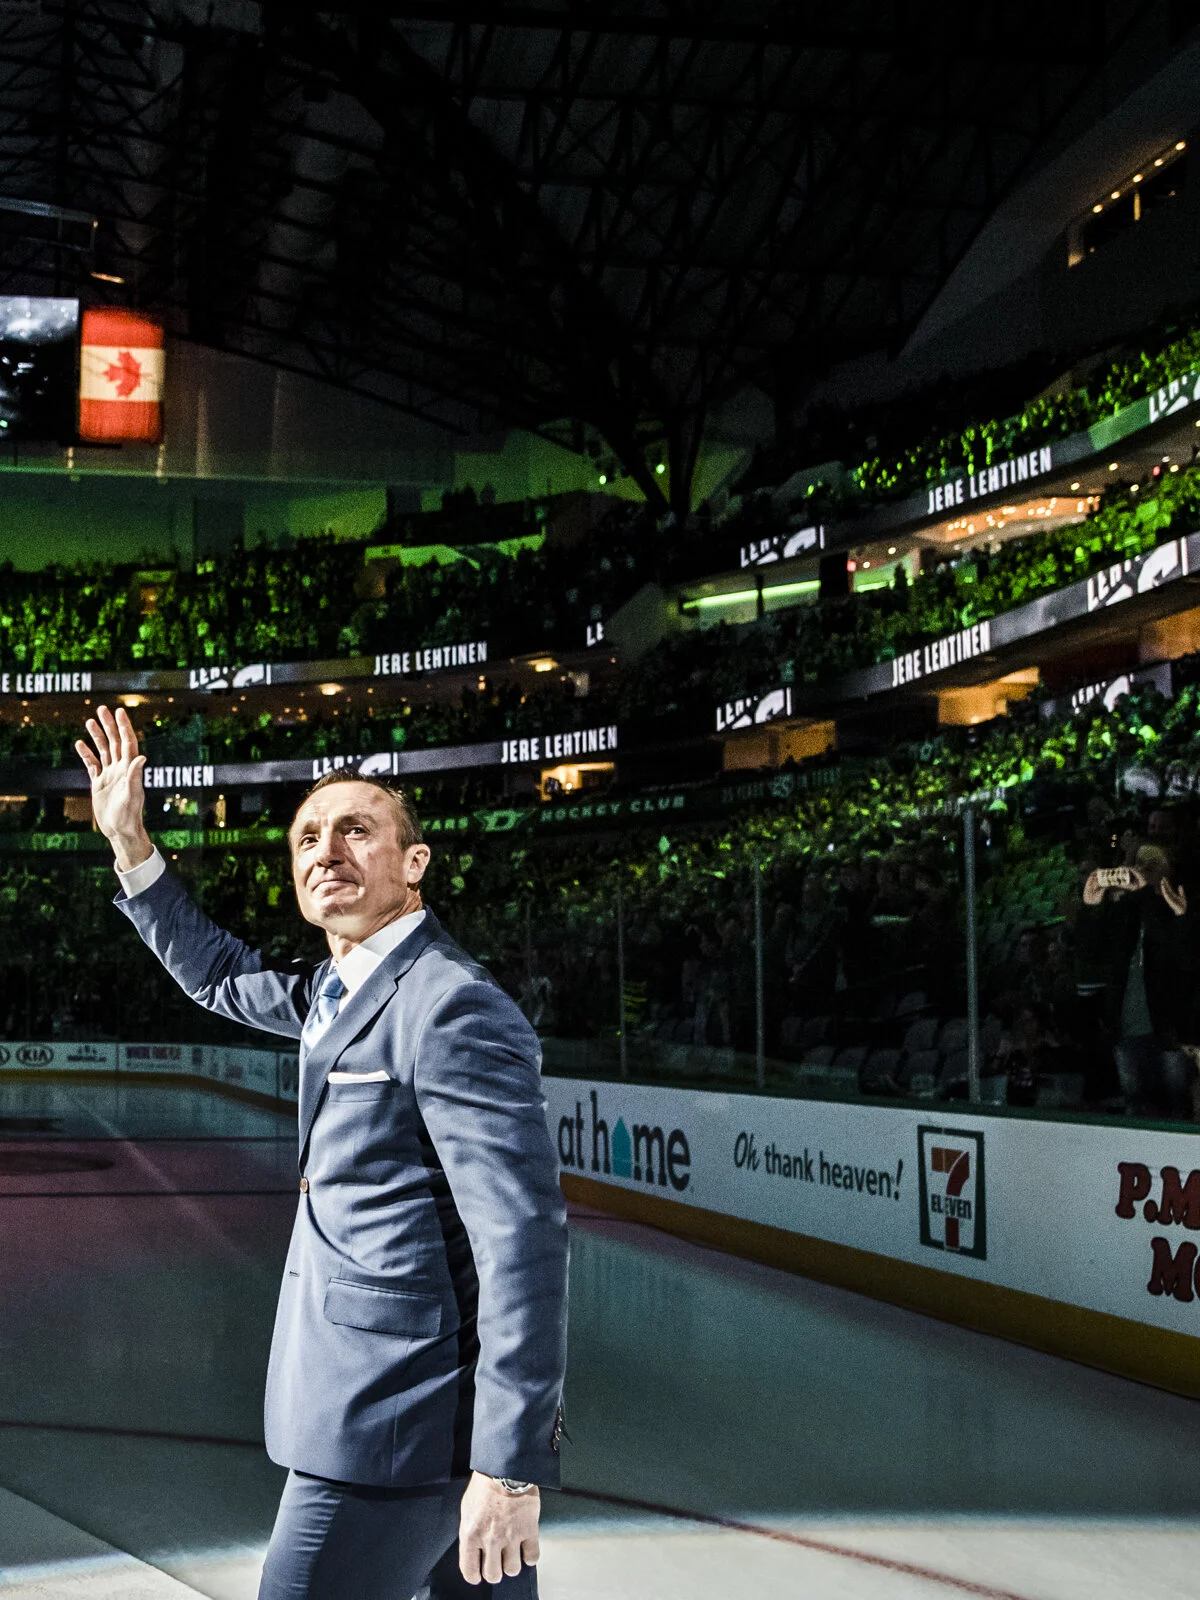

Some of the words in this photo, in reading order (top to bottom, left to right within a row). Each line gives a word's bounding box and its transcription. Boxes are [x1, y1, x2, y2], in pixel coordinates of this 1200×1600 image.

[927, 478, 964, 515] JERE
[969, 446, 1052, 498] LEHTINEN
[373, 652, 410, 676] JERE
[415, 642, 487, 671] LEHTINEN
[891, 650, 922, 688] JERE
[924, 620, 991, 675] LEHTINEN
[16, 672, 92, 693] LEHTINEN
[500, 737, 540, 764] JERE
[545, 726, 617, 759] LEHTINEN
[144, 765, 214, 788] EHTINEN
[421, 815, 469, 832] TARS
[540, 801, 622, 823] HOCKEY
[628, 795, 685, 814] CLUB
[558, 1096, 585, 1170] at
[734, 1131, 760, 1171] Oh
[764, 1143, 815, 1183] thank
[819, 1151, 903, 1201] heaven!
[1147, 1236, 1200, 1303] M
